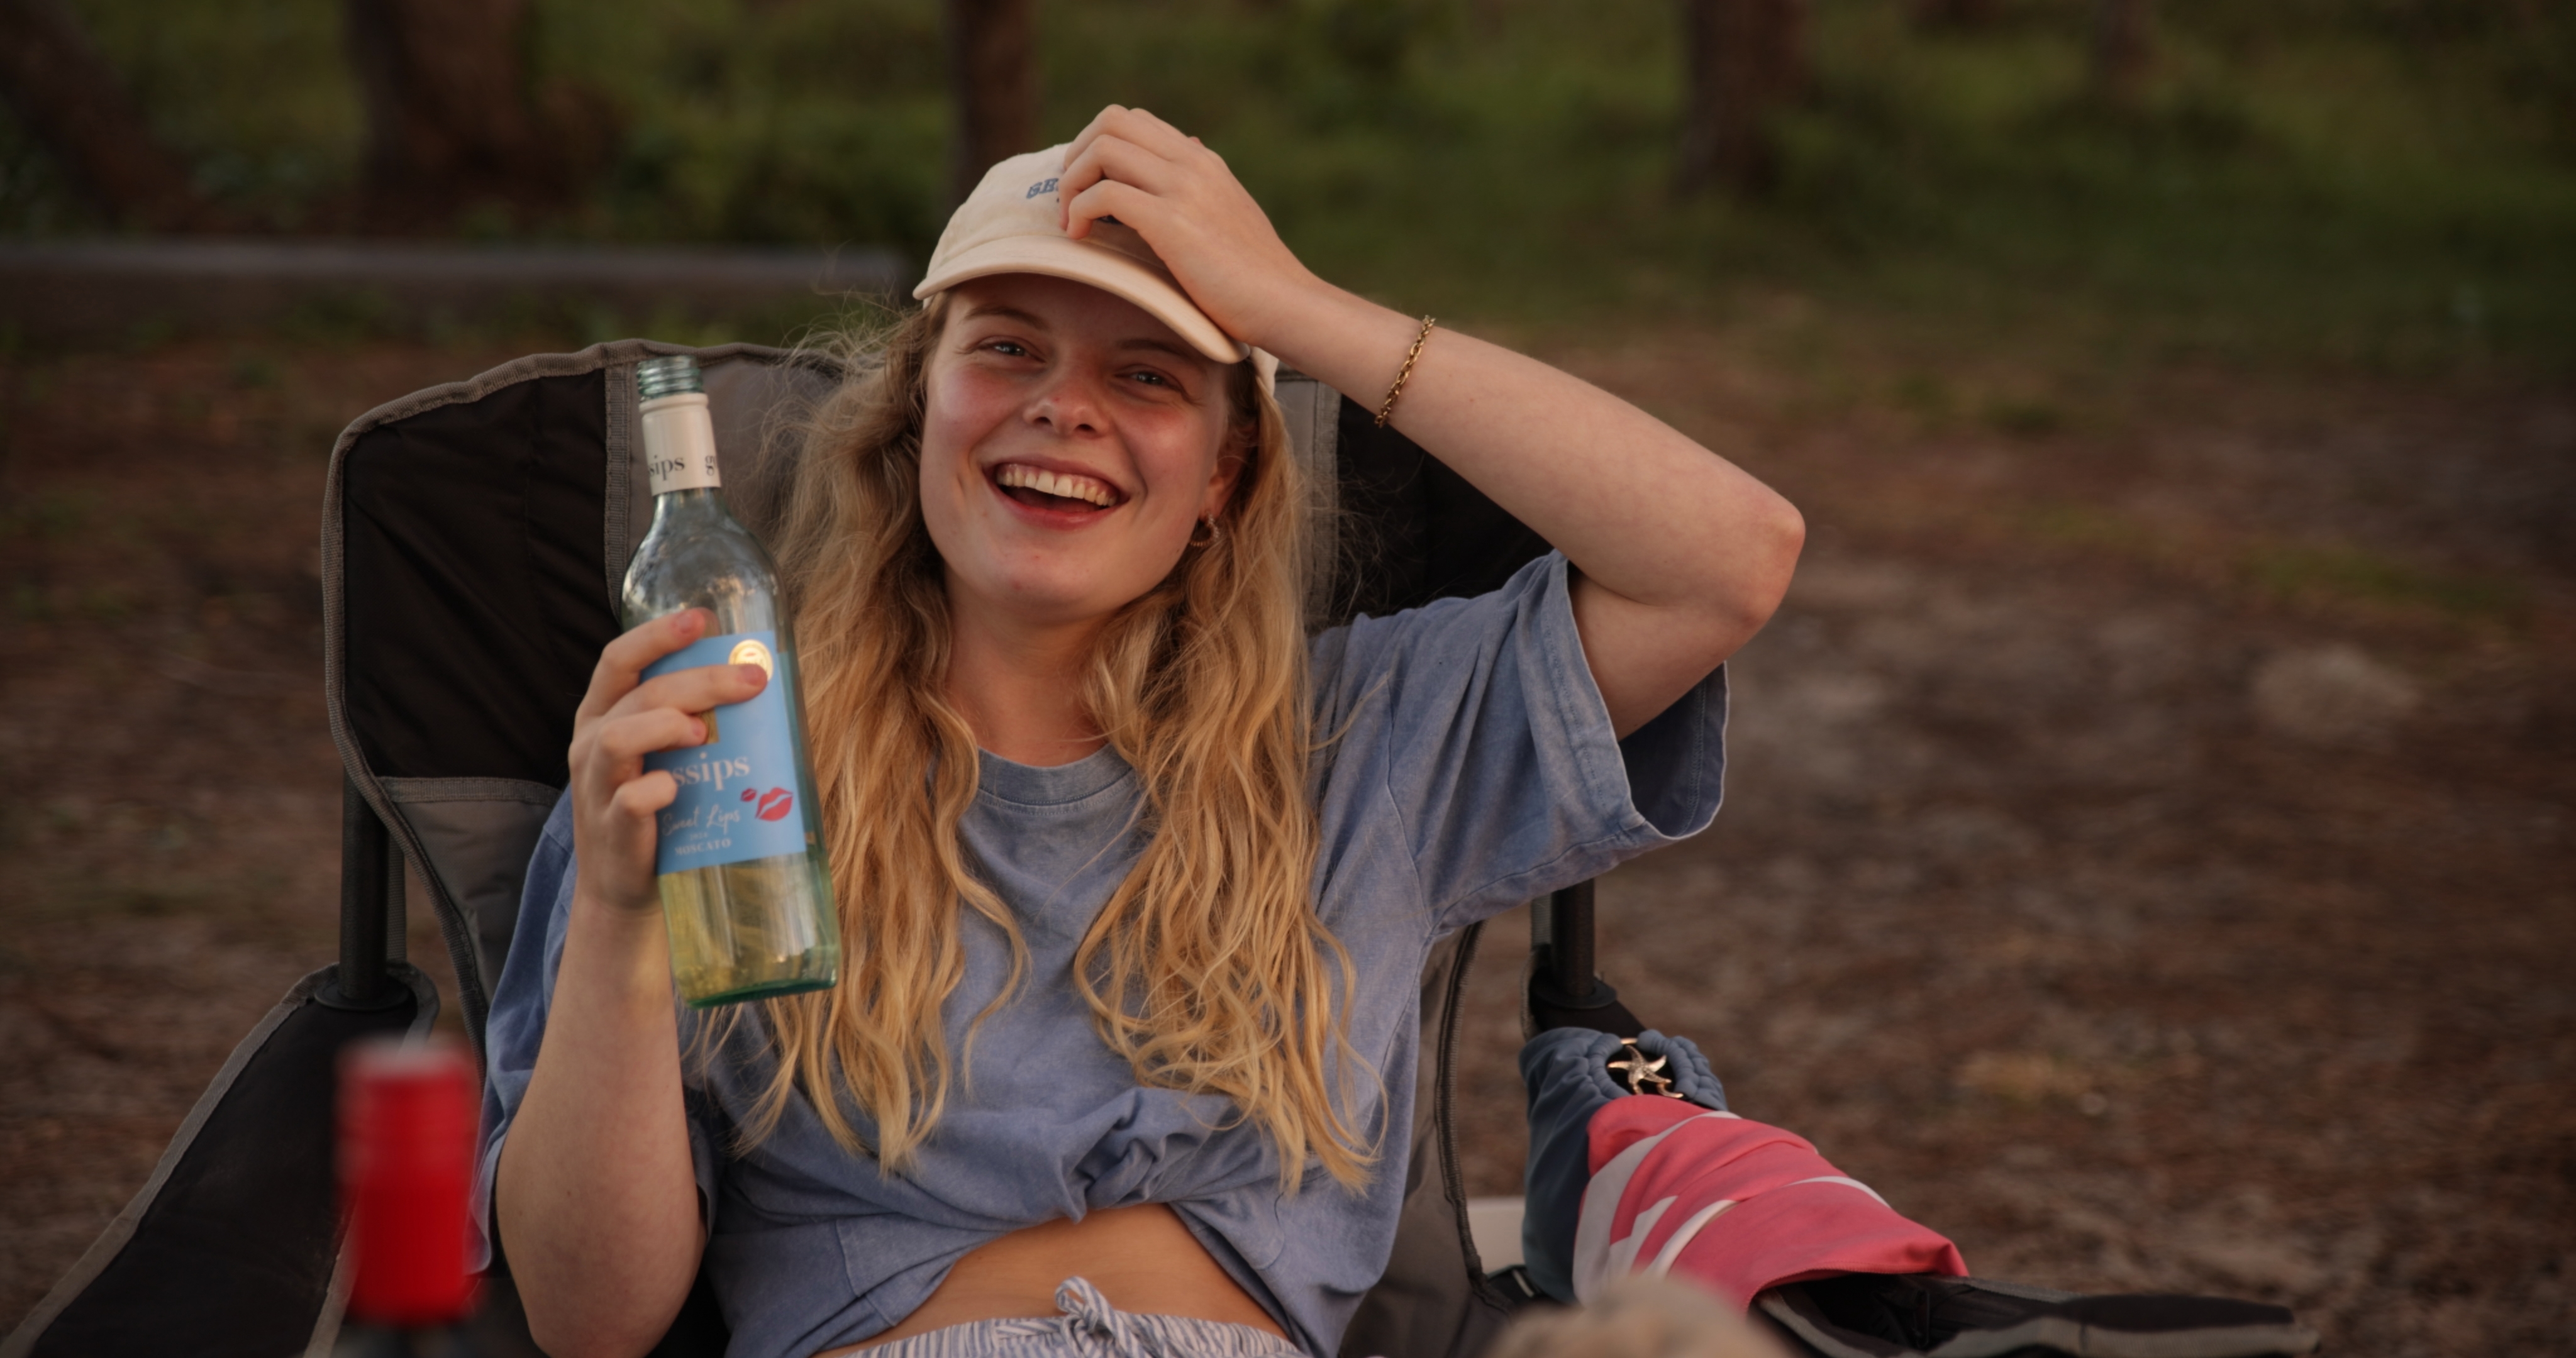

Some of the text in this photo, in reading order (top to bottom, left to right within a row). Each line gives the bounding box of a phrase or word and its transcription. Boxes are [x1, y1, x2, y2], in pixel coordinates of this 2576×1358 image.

[705, 455, 717, 476] g
[662, 803, 741, 836] Sweet Lips
[674, 837, 732, 856] MOSCATO
